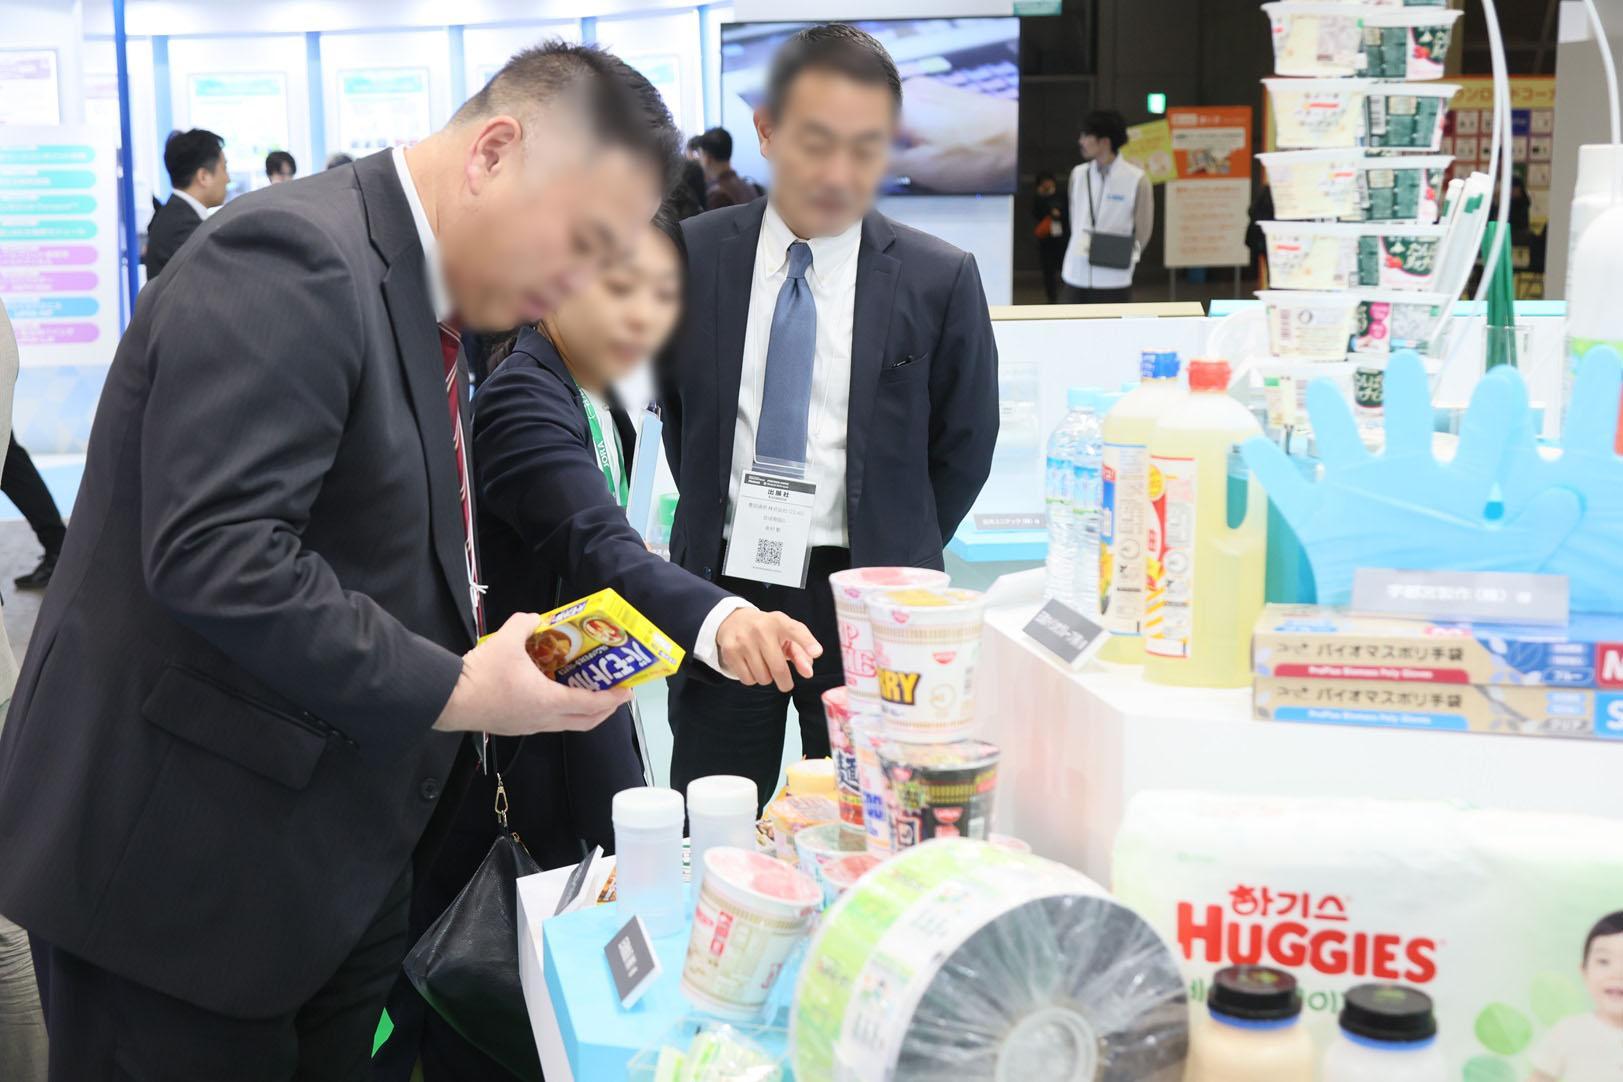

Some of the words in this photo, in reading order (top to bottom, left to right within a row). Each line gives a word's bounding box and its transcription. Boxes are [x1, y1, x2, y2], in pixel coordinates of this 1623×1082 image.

[597, 440, 610, 468] JORA
[1316, 644, 1464, 661] バイオマスポリ手袋
[1315, 686, 1463, 708] バイオマスポリ手袋
[1228, 883, 1349, 922] 하기스
[1176, 901, 1438, 984] HUGGIES
